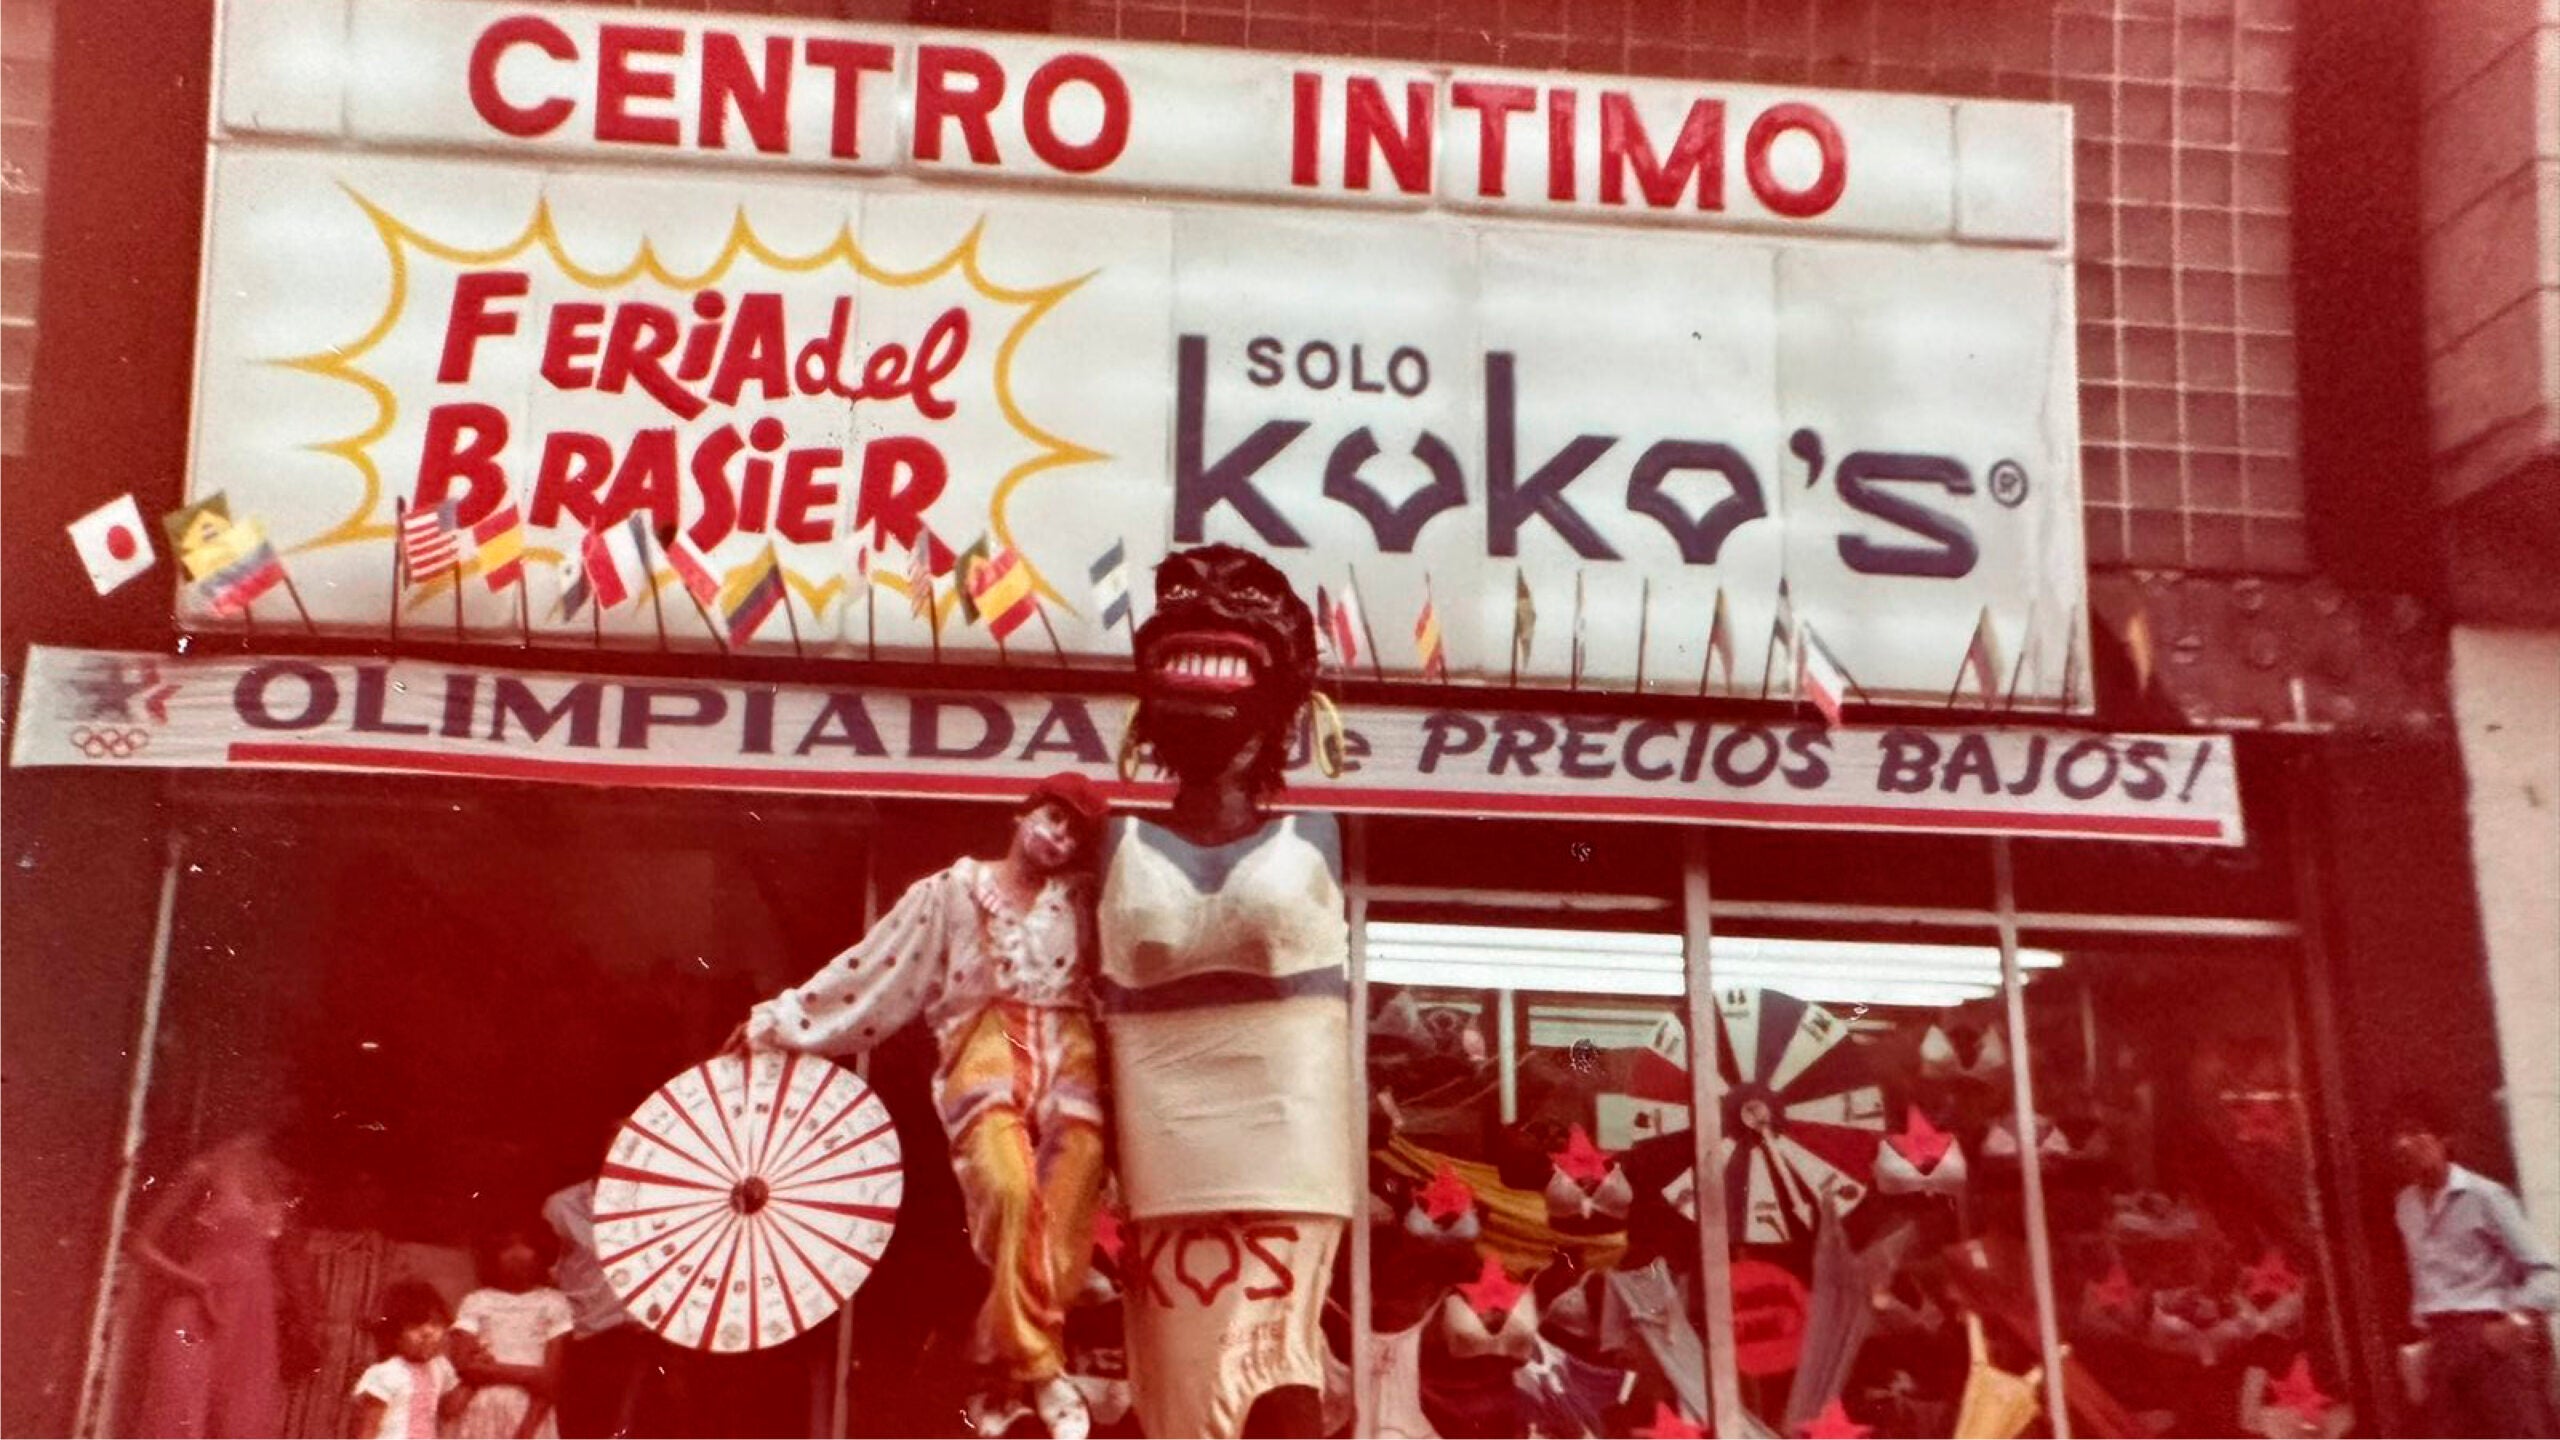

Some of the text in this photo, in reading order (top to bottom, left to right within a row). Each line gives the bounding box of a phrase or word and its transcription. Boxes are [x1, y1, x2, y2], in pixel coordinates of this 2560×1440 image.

[467, 15, 1847, 218] CENTRO INTIMO
[794, 296, 970, 420] del
[1247, 337, 1431, 397] SOLO
[233, 659, 1166, 768] OLIMPIADA
[1418, 711, 1834, 790] PRECIOS
[1877, 729, 2211, 805] BAJOS!
